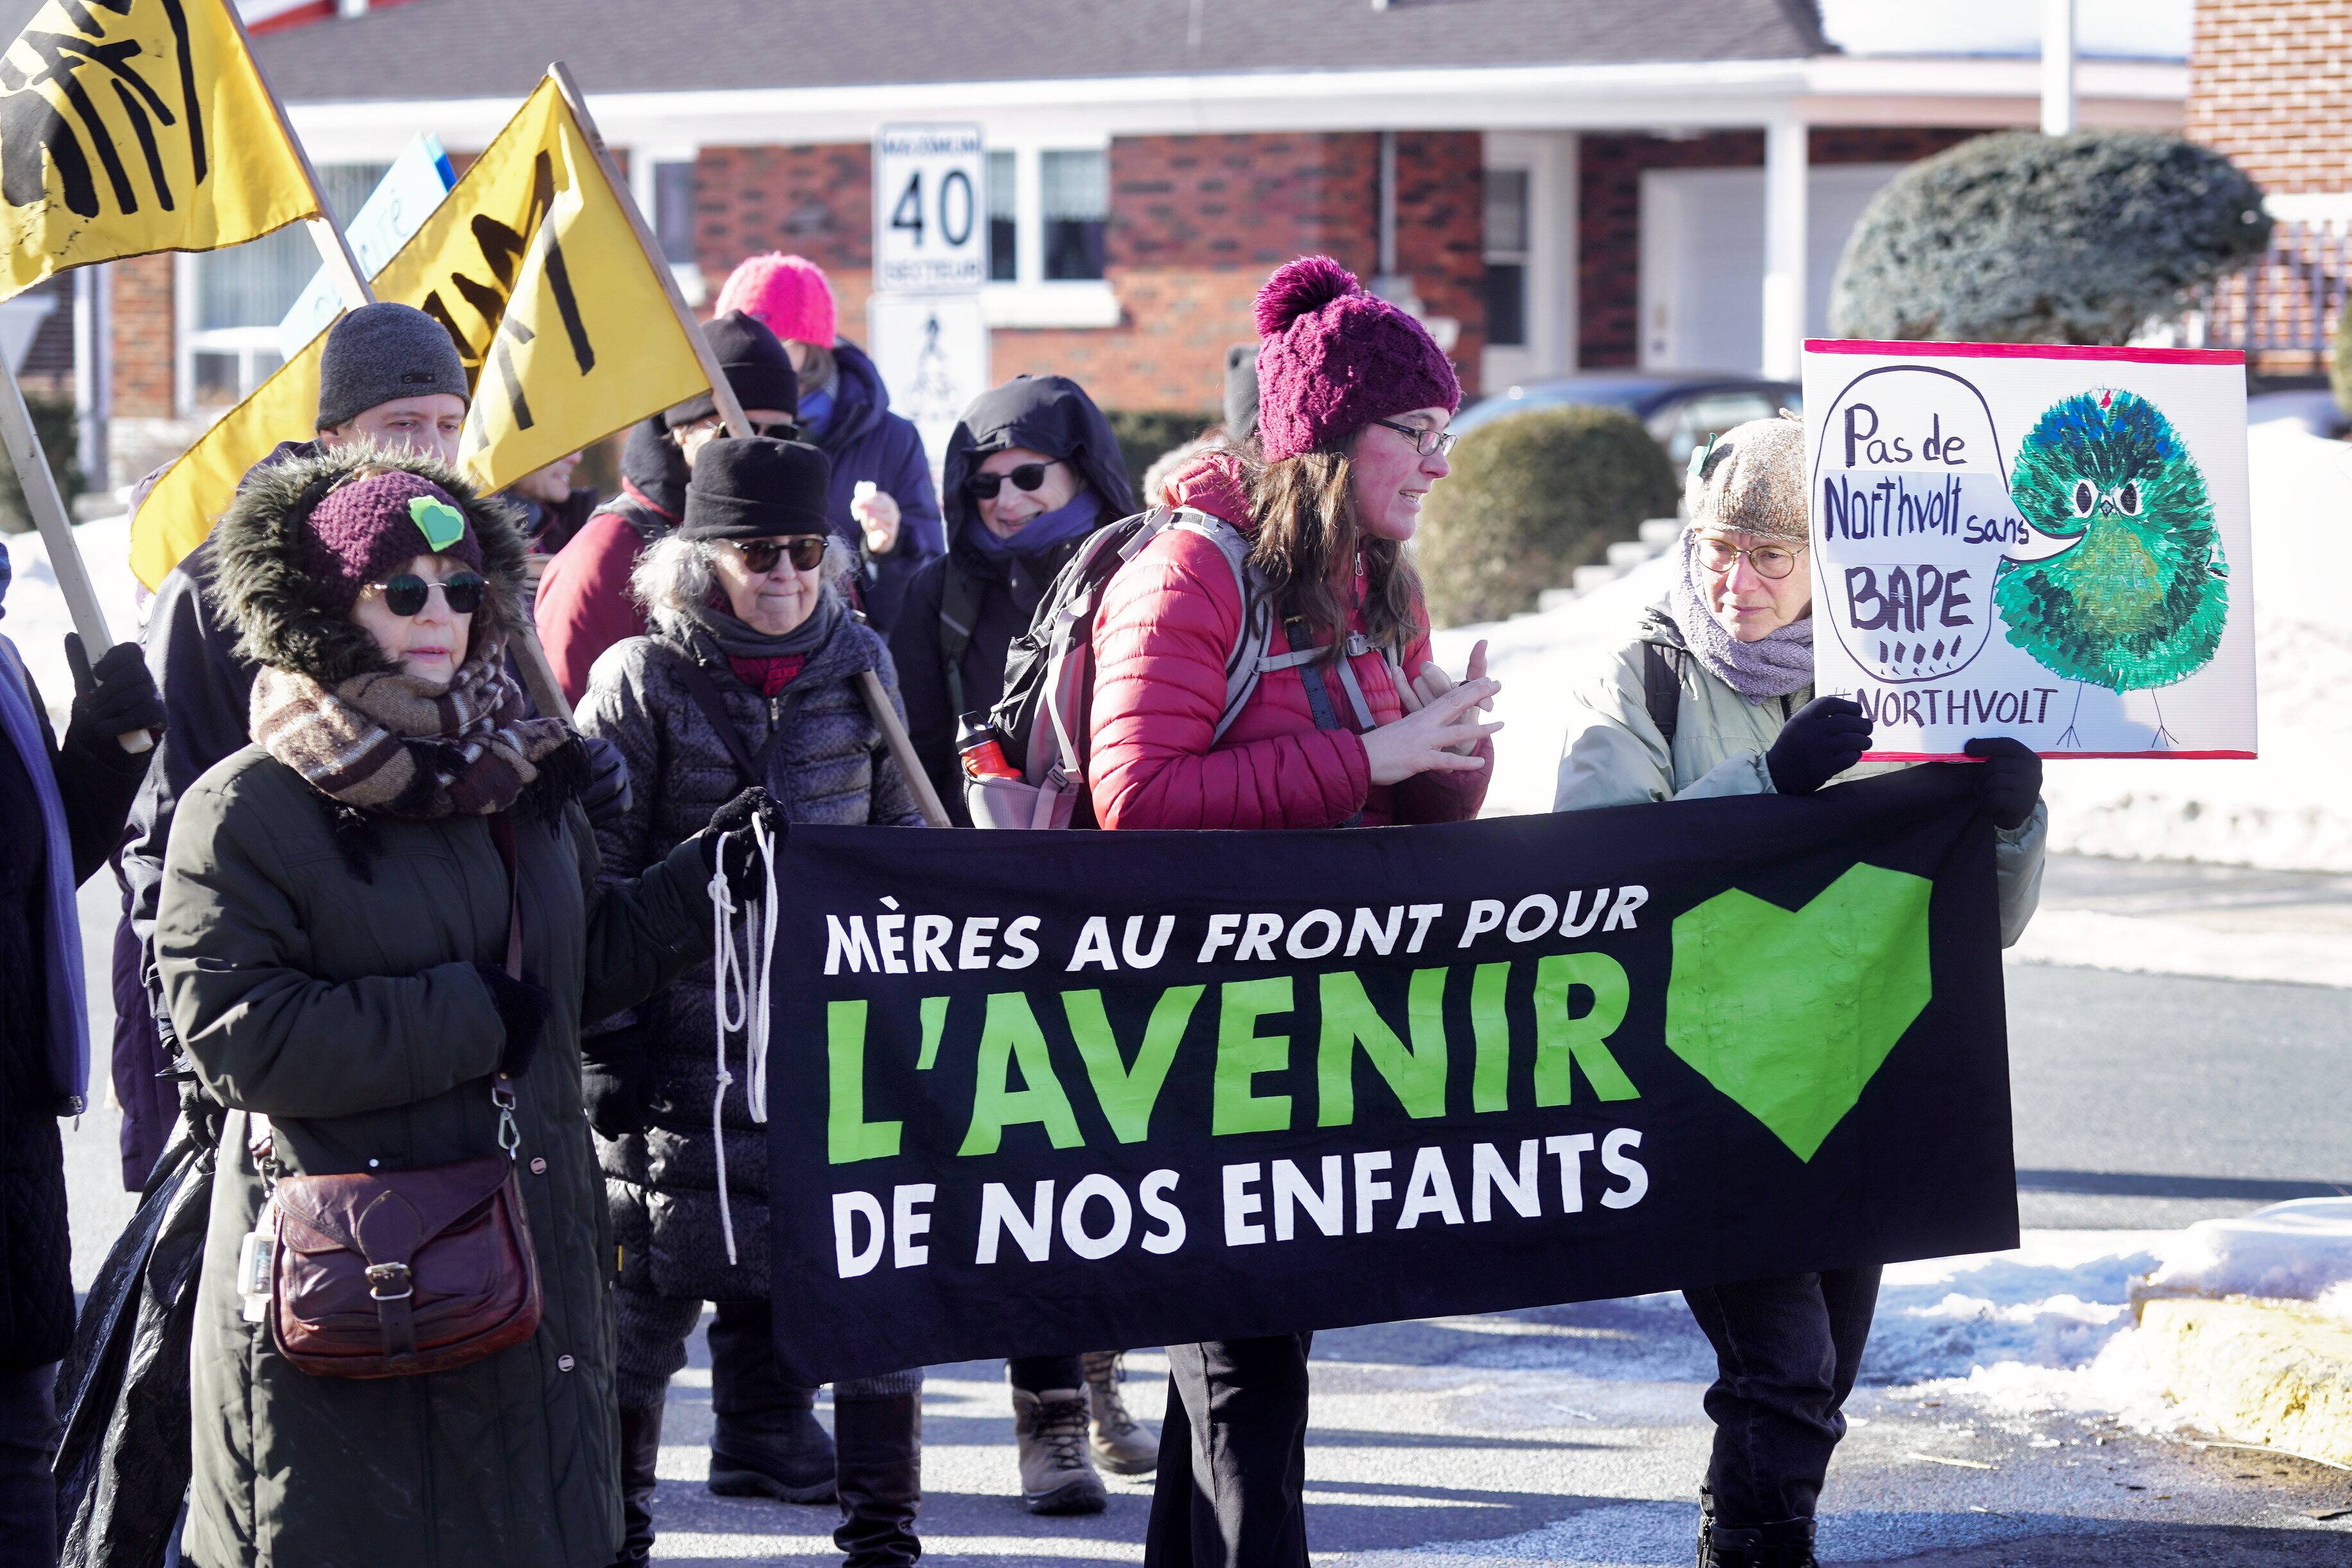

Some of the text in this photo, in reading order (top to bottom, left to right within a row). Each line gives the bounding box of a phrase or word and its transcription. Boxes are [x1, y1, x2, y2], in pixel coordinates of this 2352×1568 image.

[890, 168, 973, 248] 40
[1844, 403, 1967, 469] Pas de
[1962, 514, 2030, 545] sans
[1844, 564, 1974, 634] BAPE
[823, 884, 1650, 977] MÈRES AU FRONT POUR
[826, 951, 1641, 1166] L'AVENIR
[831, 1127, 1650, 1280] DE NOS ENFANTS
